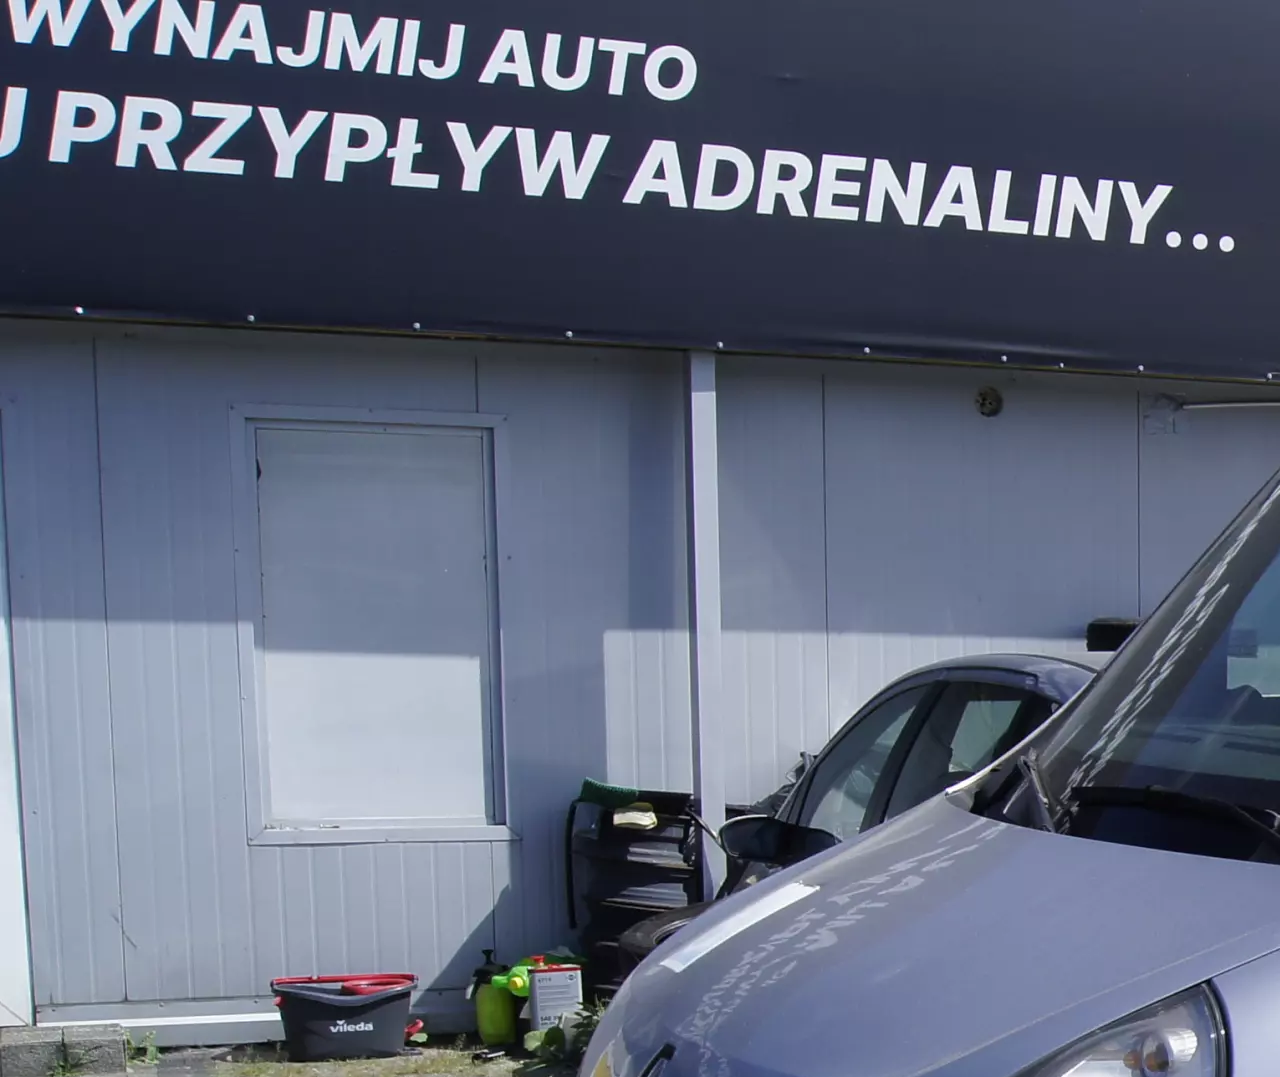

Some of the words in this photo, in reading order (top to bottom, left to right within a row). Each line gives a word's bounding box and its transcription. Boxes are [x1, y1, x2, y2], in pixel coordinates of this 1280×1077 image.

[7, 0, 465, 79] WYNAJMIJ
[478, 28, 698, 101] AUTO
[48, 90, 611, 200] PRZYPŁYW
[622, 139, 1235, 253] ADRENALINY...
[329, 1019, 374, 1033] vileda
